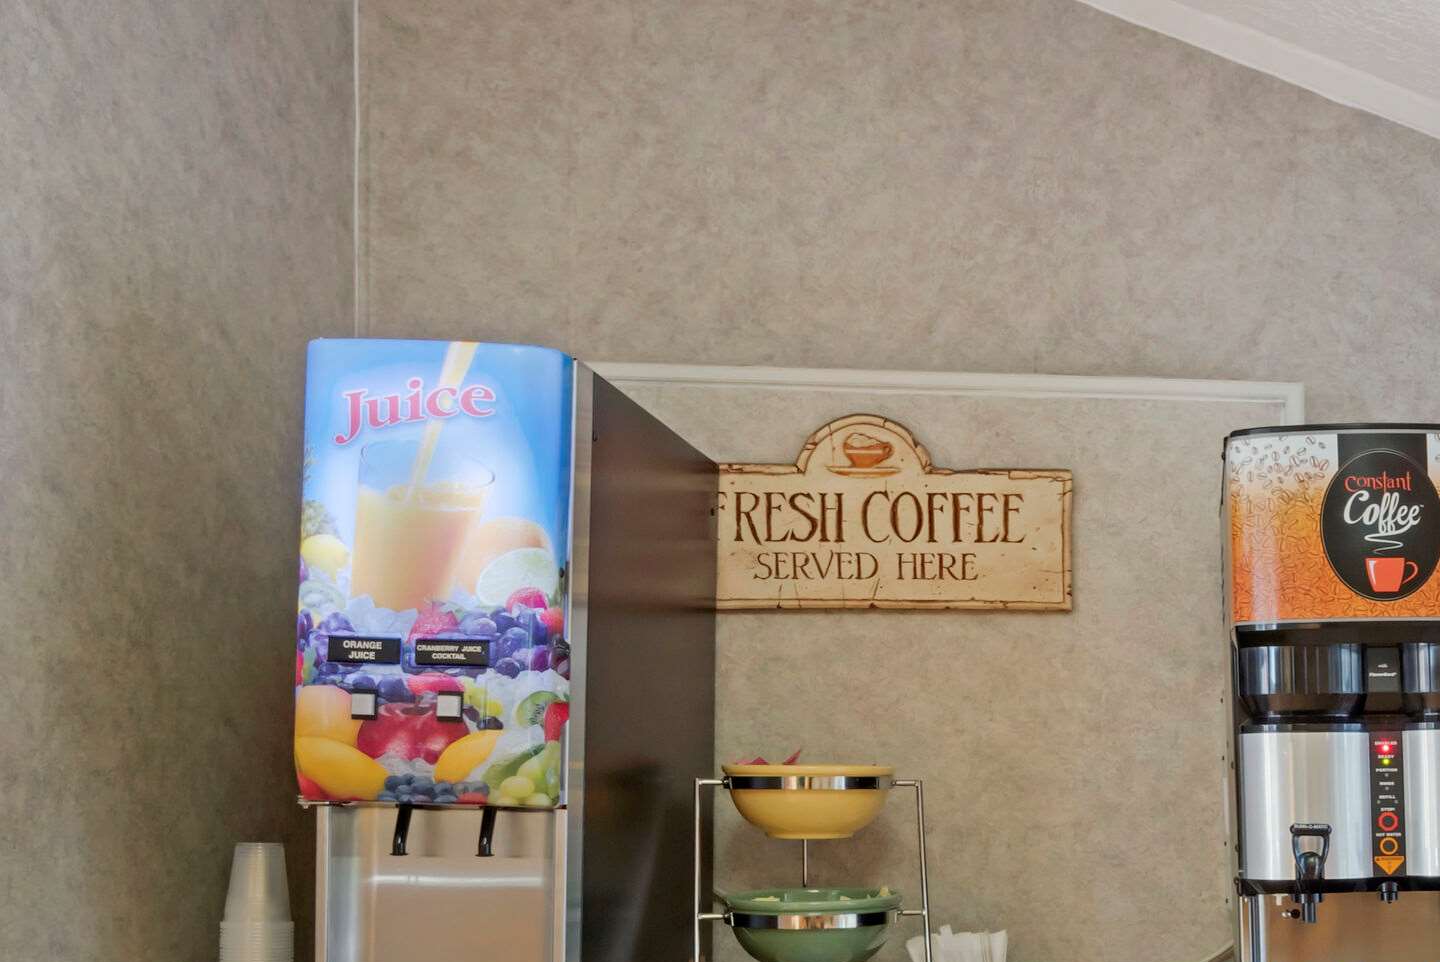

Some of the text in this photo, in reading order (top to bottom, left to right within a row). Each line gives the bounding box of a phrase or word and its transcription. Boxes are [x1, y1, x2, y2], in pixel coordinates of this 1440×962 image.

[336, 378, 496, 445] Juice
[861, 490, 1026, 544] COFFEE
[1343, 490, 1421, 535] Coffee
[753, 552, 979, 581] SERVED HERE
[343, 640, 382, 649] ORANGE
[348, 651, 375, 660] JUICE
